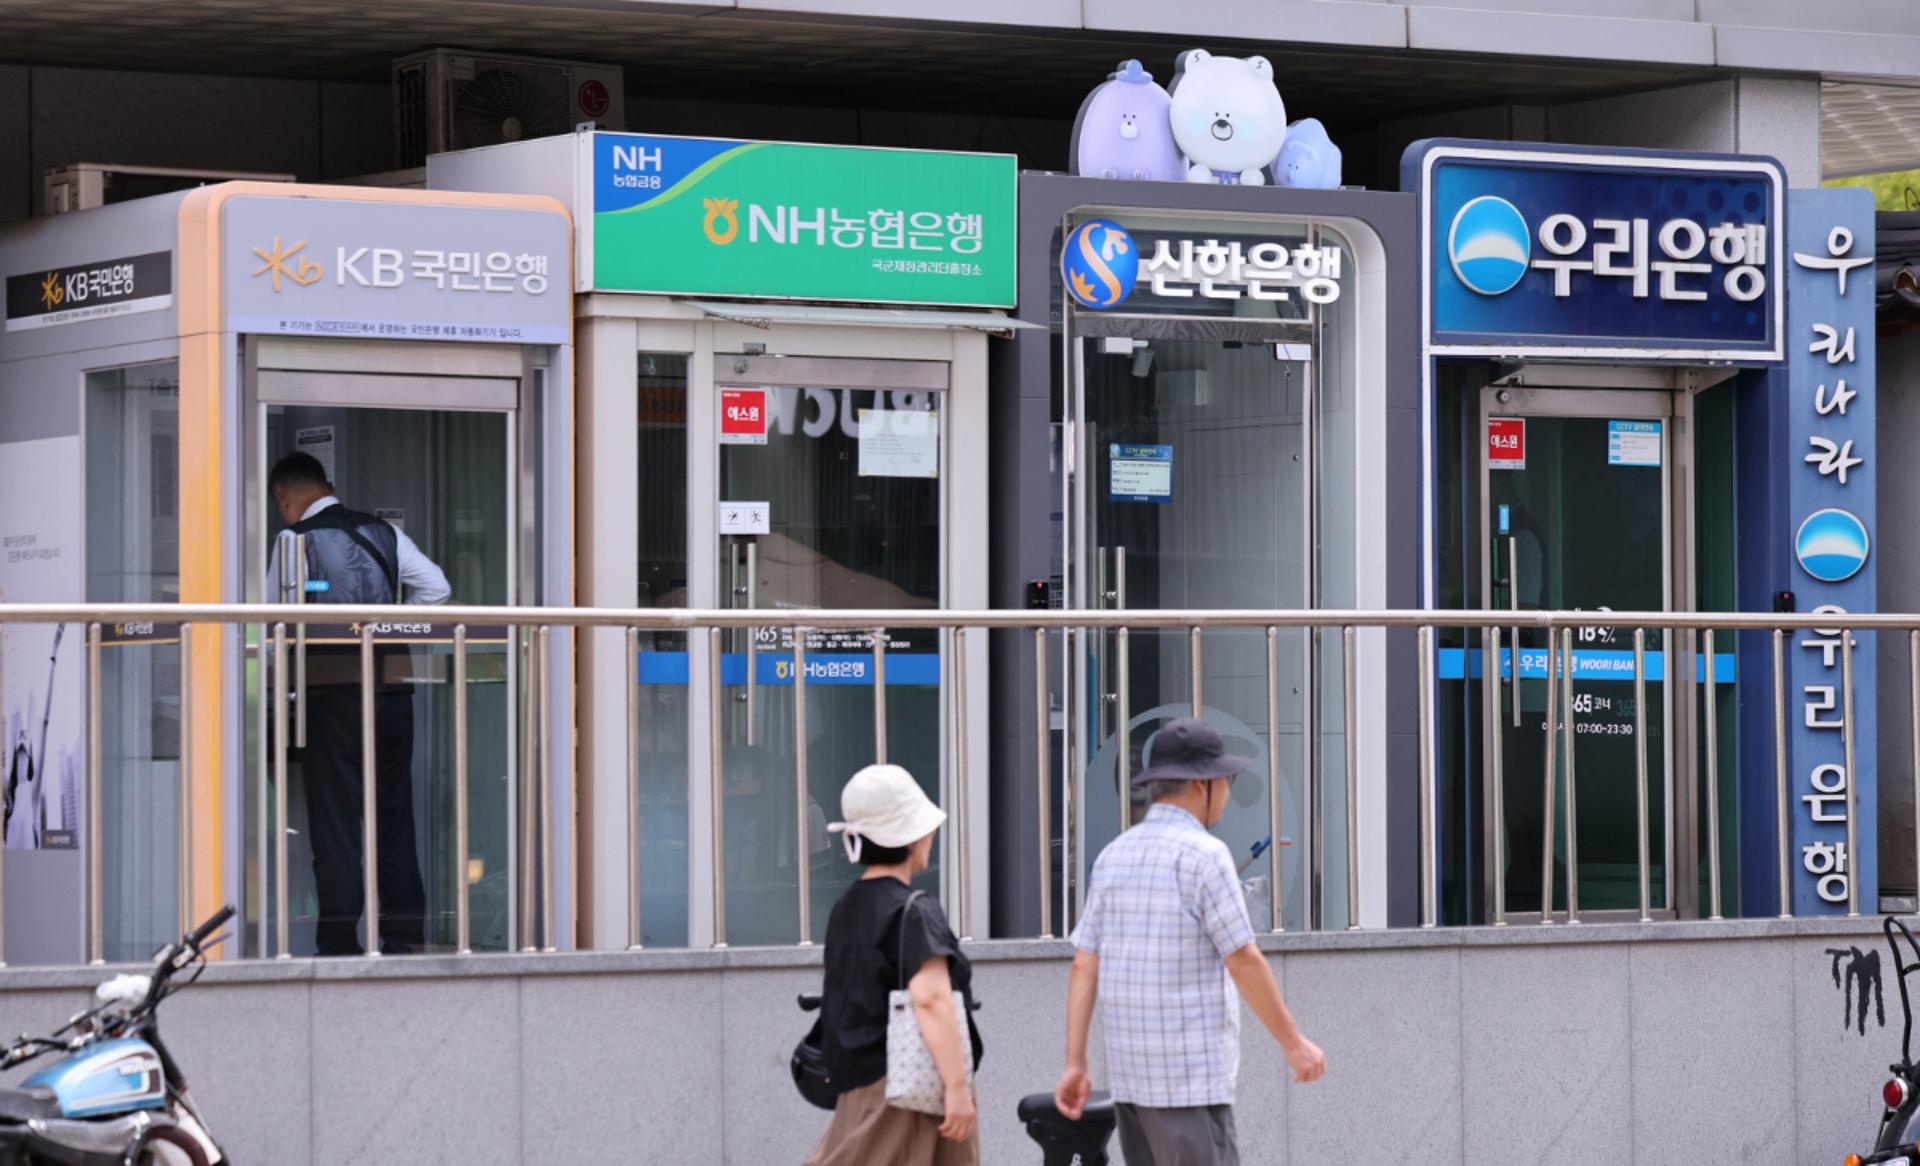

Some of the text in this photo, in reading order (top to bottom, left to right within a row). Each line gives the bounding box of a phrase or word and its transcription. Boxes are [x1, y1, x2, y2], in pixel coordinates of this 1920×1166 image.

[613, 145, 661, 171] NH
[613, 174, 661, 190] 농협금융
[749, 203, 984, 254] NH농협은행
[1149, 238, 1341, 304] 신한은행
[1531, 213, 1766, 301] 우리은행
